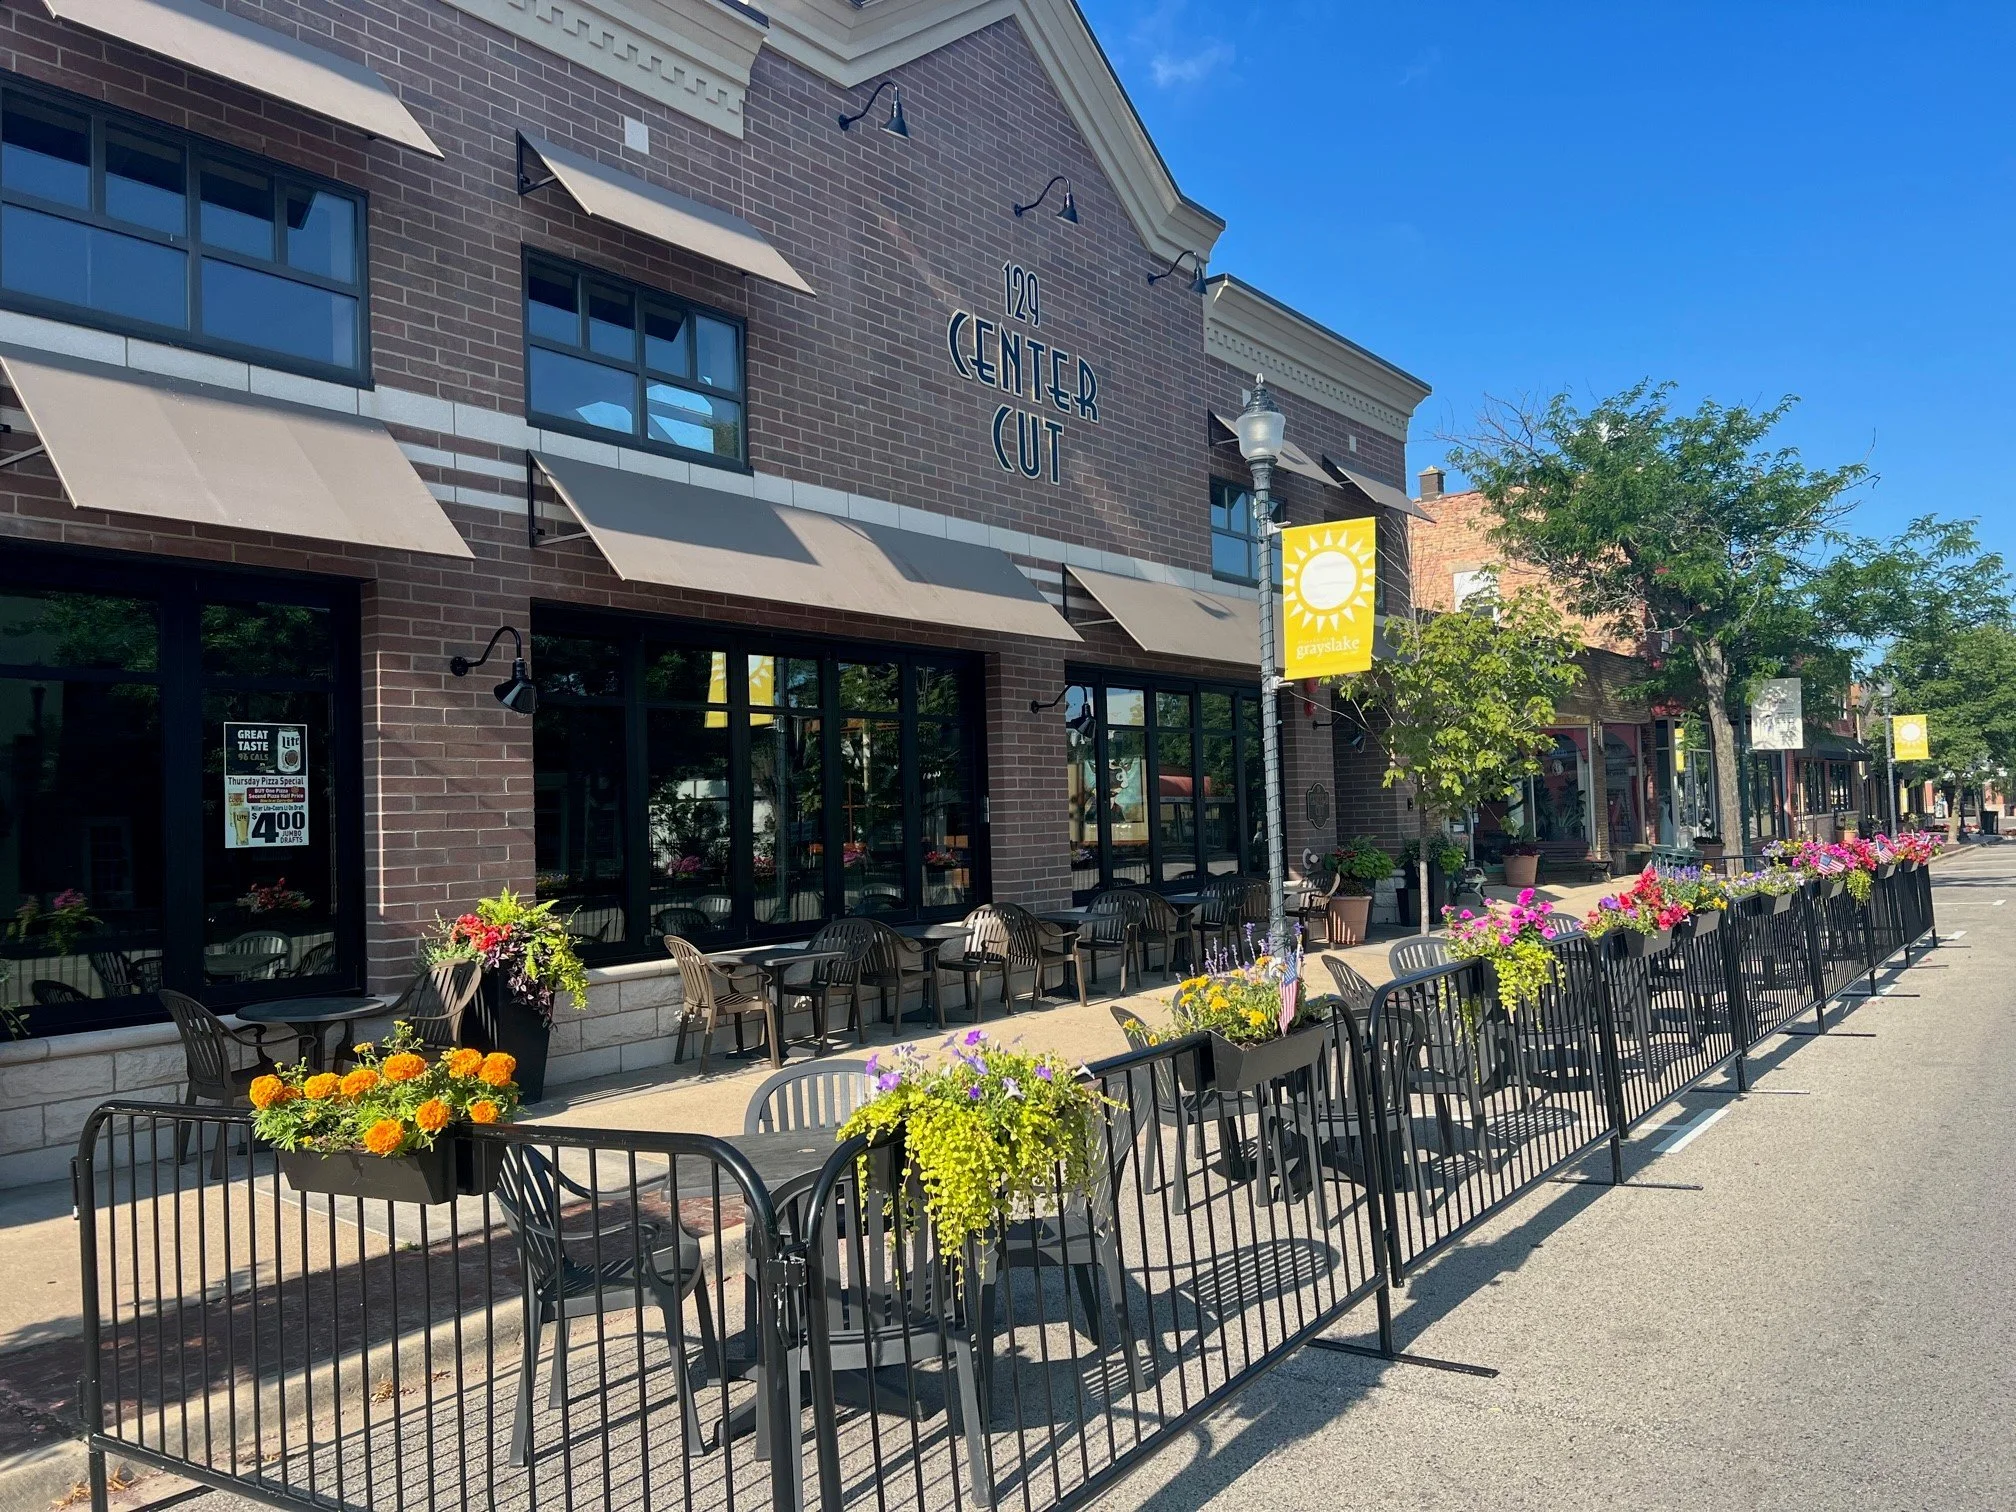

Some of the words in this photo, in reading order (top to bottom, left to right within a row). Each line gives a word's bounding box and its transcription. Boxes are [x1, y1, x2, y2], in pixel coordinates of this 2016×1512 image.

[1002, 259, 1040, 329] 129
[947, 308, 1099, 423] CENTER
[991, 404, 1064, 485] CUT
[1296, 635, 1360, 660] grayslake
[237, 729, 269, 740] GREAT
[237, 741, 269, 751] TASTE
[281, 736, 300, 749] Lite
[250, 753, 269, 761] CALS
[228, 776, 260, 787] Thursday
[261, 776, 279, 785] Pizza
[279, 776, 304, 787] Special
